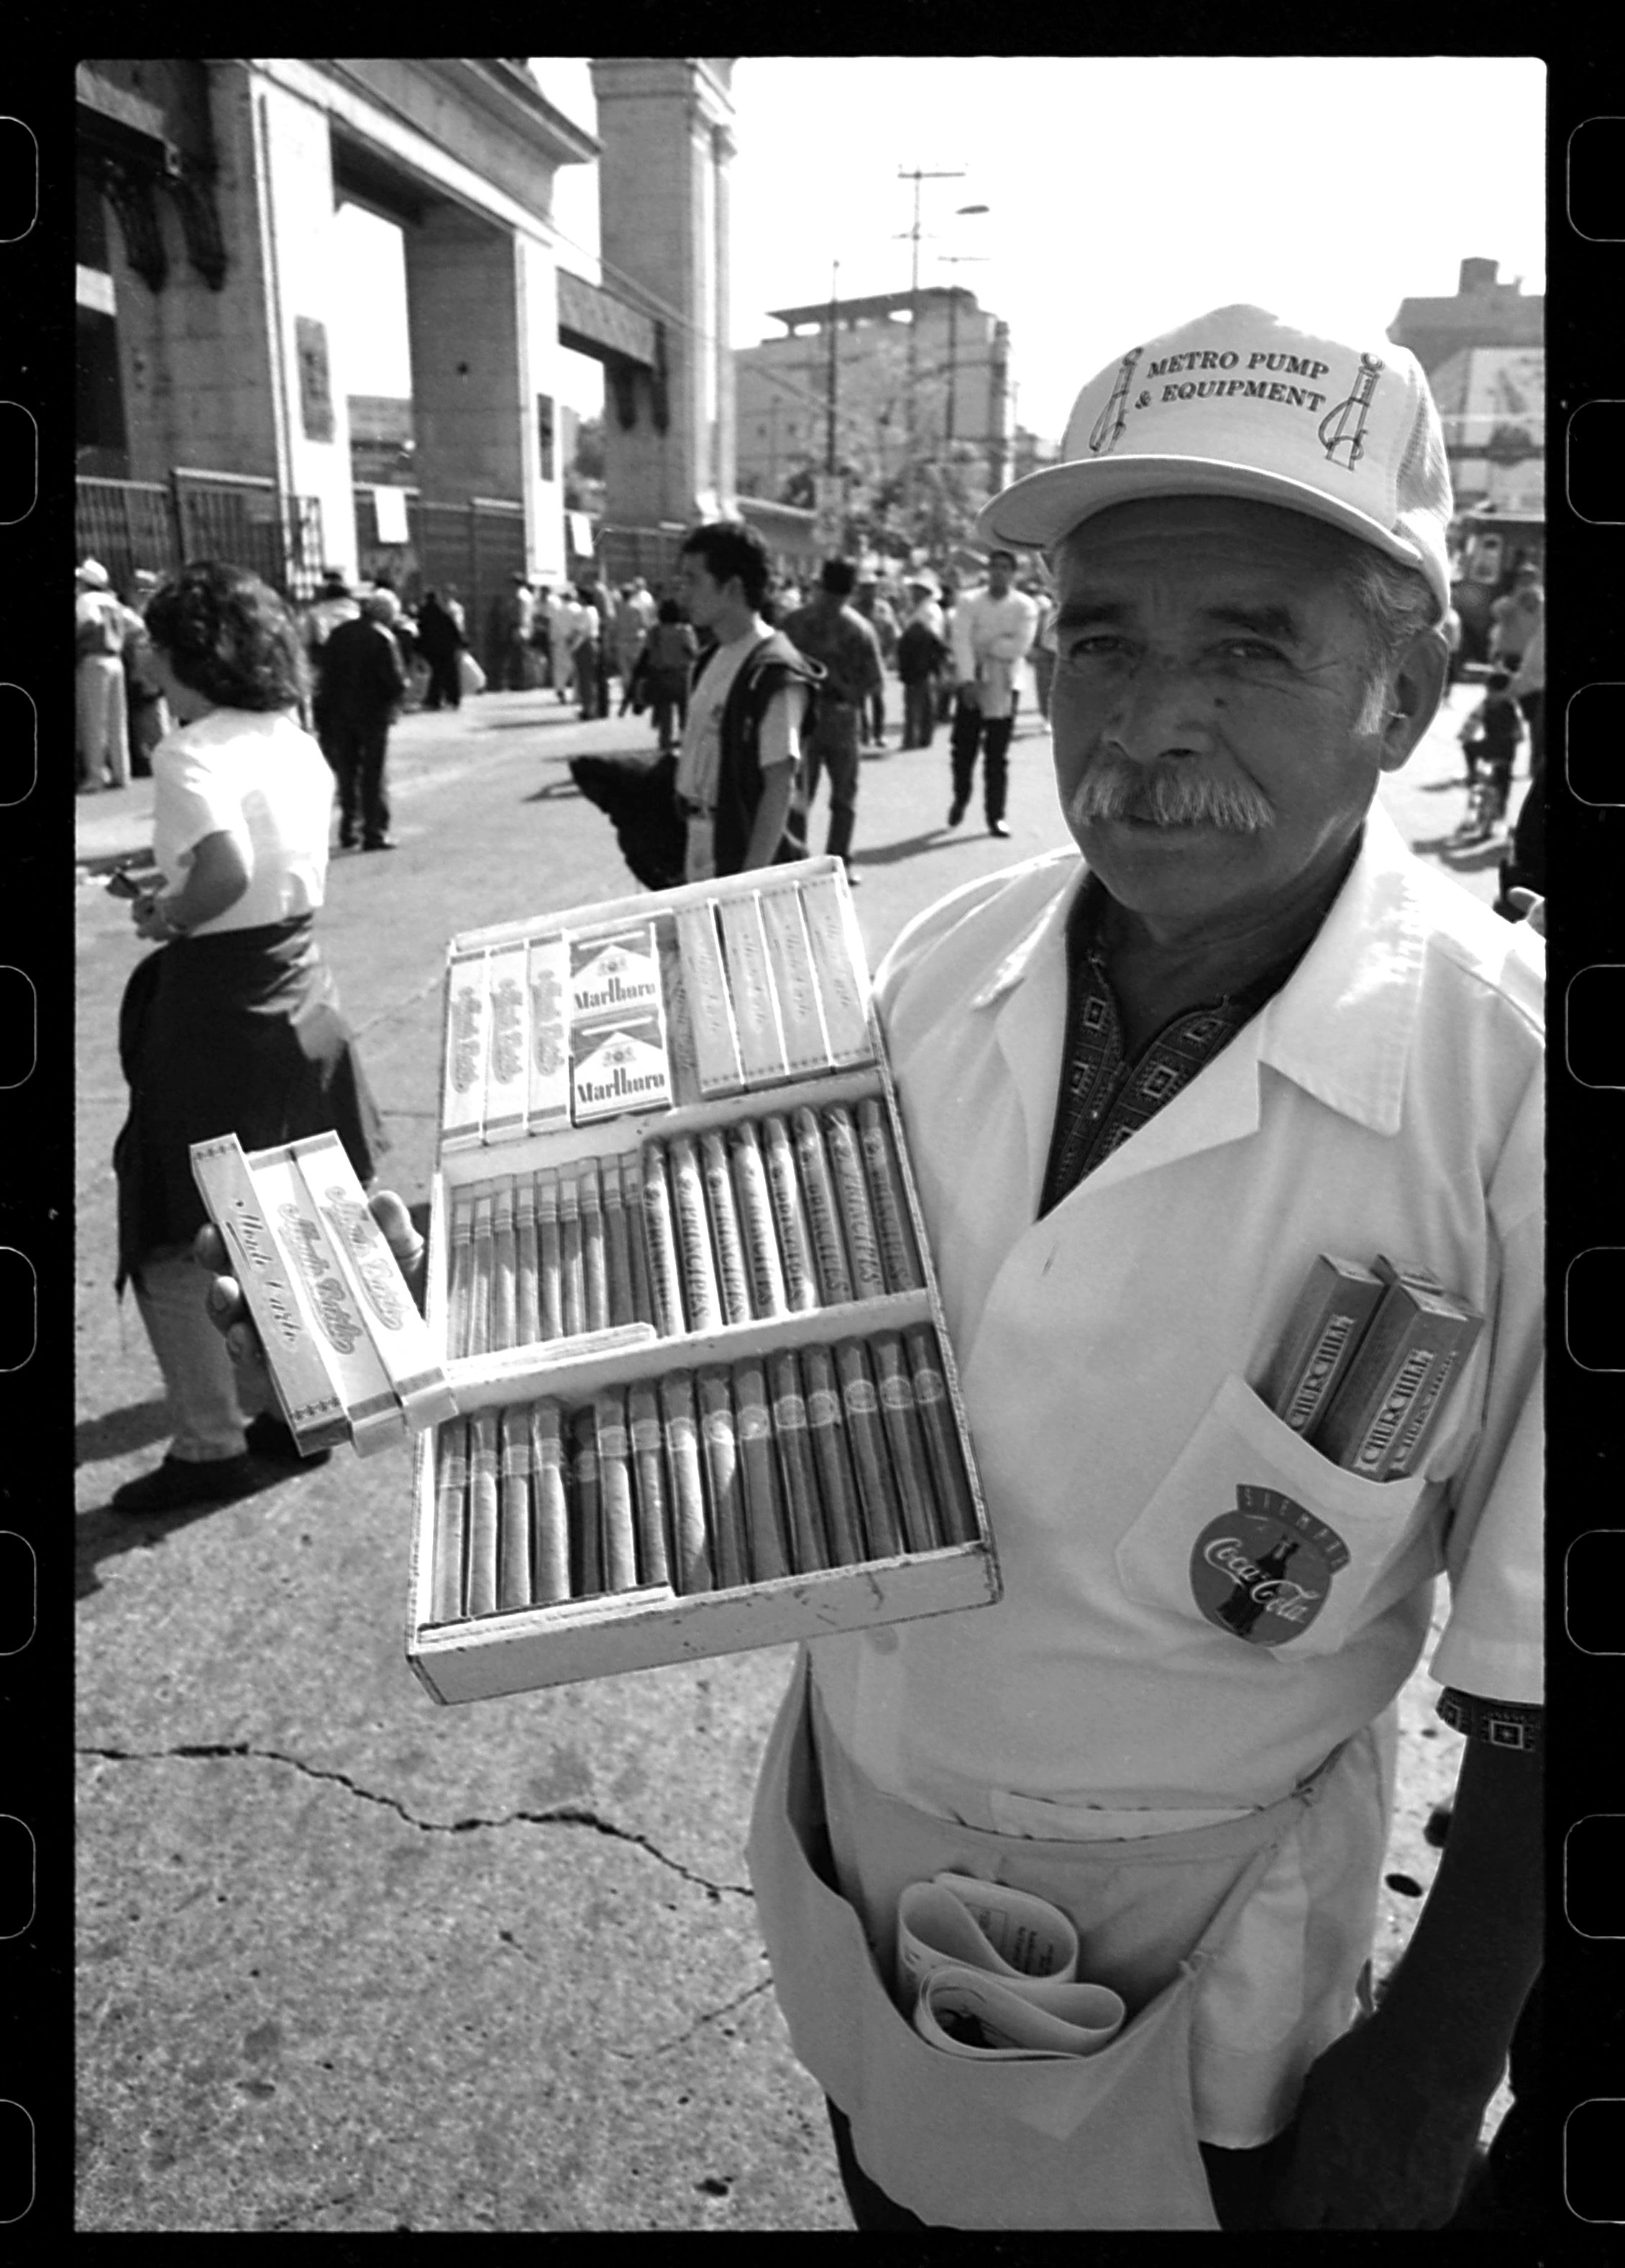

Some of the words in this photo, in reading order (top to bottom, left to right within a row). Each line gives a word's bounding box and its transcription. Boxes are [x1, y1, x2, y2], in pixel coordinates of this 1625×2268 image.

[1147, 350, 1240, 379] METRO
[1246, 352, 1329, 380] PUMP
[1135, 390, 1151, 410] &
[1161, 380, 1327, 413] EQUIPMENT
[577, 1067, 665, 1103] Marlboro
[1287, 1324, 1349, 1430] CHURCHILL
[1360, 1357, 1429, 1464] CHURCHILL
